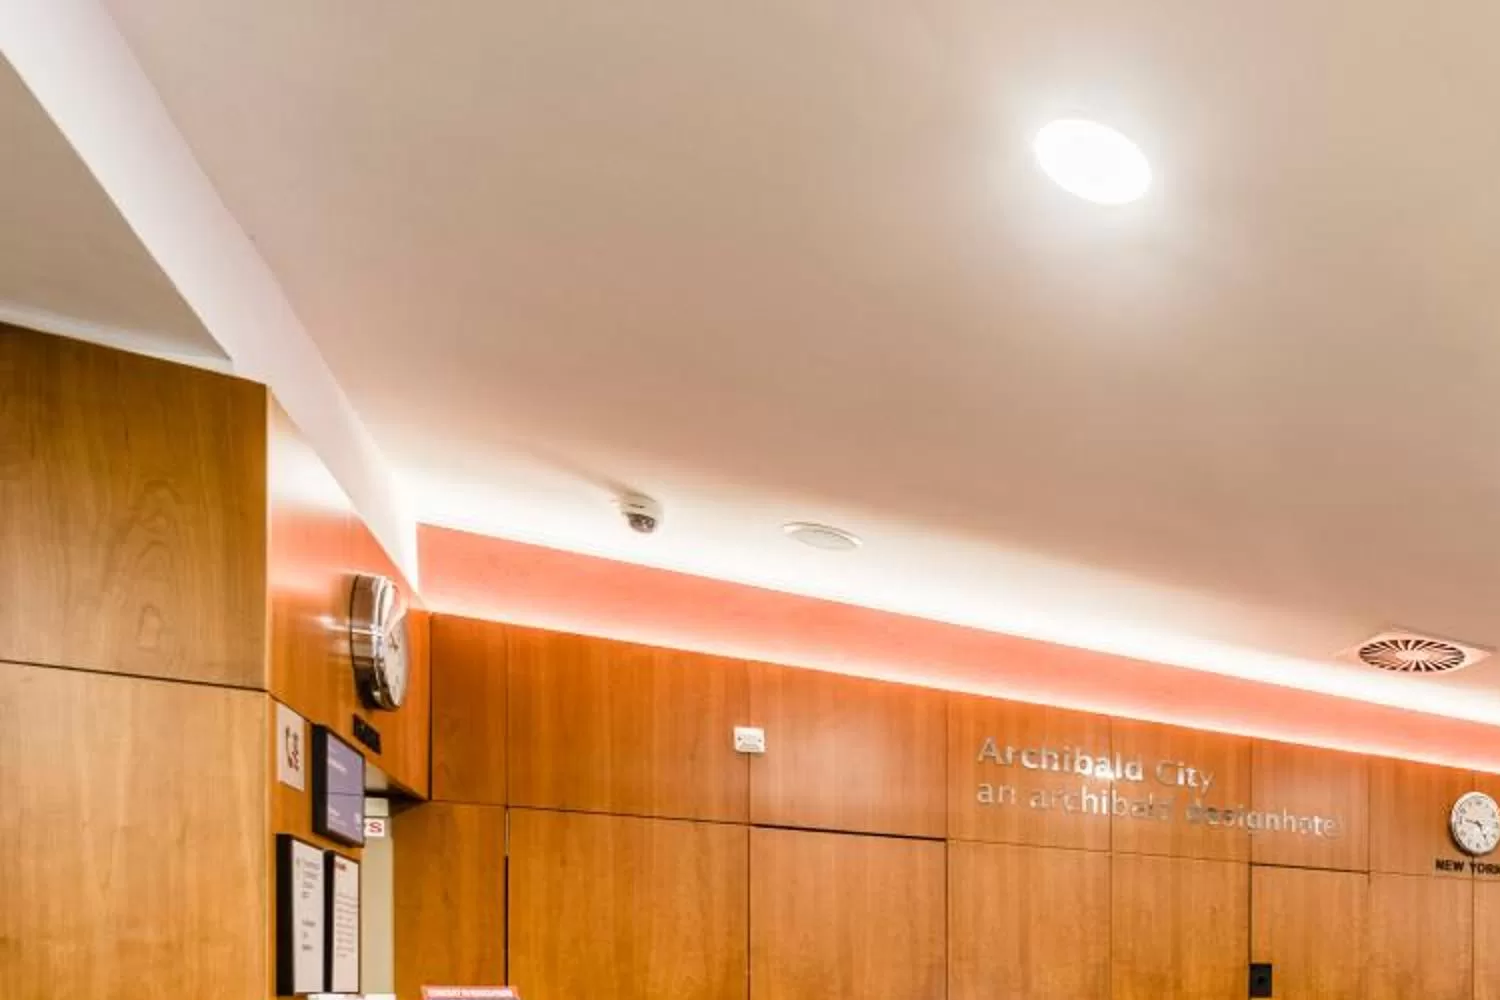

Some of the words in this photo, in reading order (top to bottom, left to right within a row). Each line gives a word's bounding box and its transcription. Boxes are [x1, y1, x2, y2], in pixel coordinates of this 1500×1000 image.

[977, 736, 1144, 781] Archibald
[1156, 760, 1214, 796] City
[977, 783, 1016, 805] an
[1435, 859, 1465, 872] NEW
